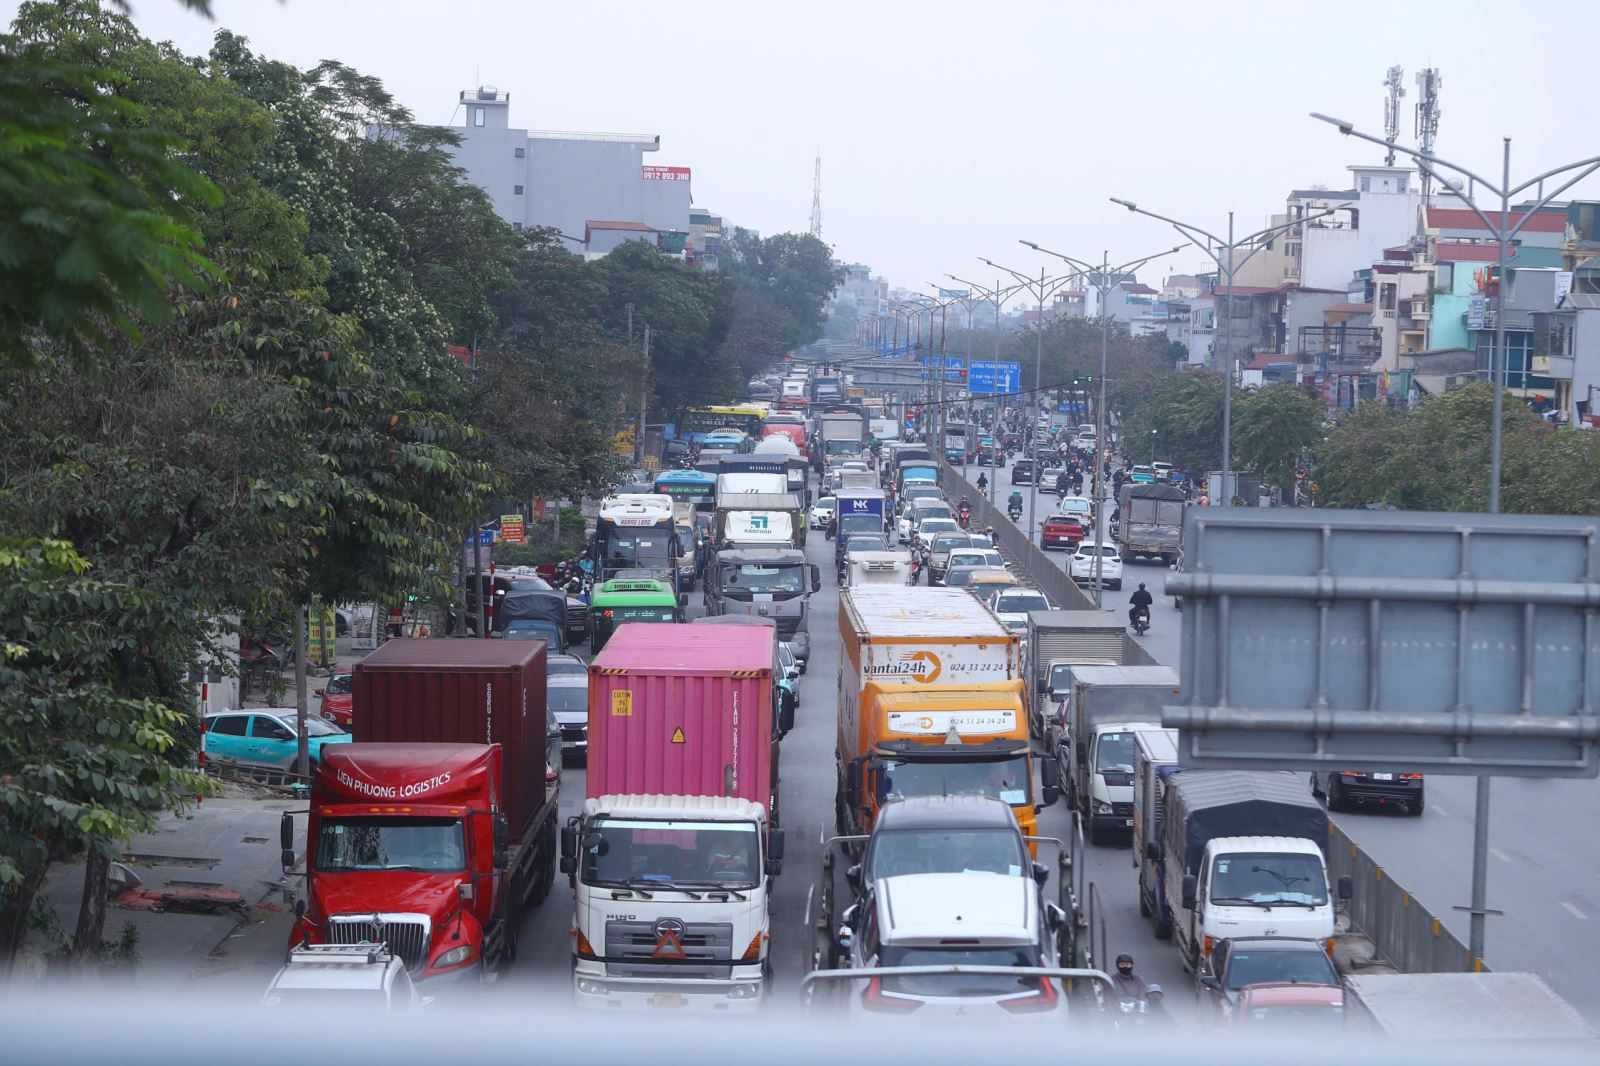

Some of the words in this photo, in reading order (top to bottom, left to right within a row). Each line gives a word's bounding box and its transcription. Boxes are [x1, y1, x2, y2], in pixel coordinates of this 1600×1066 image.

[853, 500, 868, 508] NK
[864, 660, 926, 674] vantai24h
[950, 663, 965, 671] 024
[980, 663, 990, 671] 24
[993, 663, 1003, 671] 24
[336, 769, 353, 788] LIEN
[354, 780, 396, 798] PHUONG
[399, 771, 451, 797] LOGISTICS
